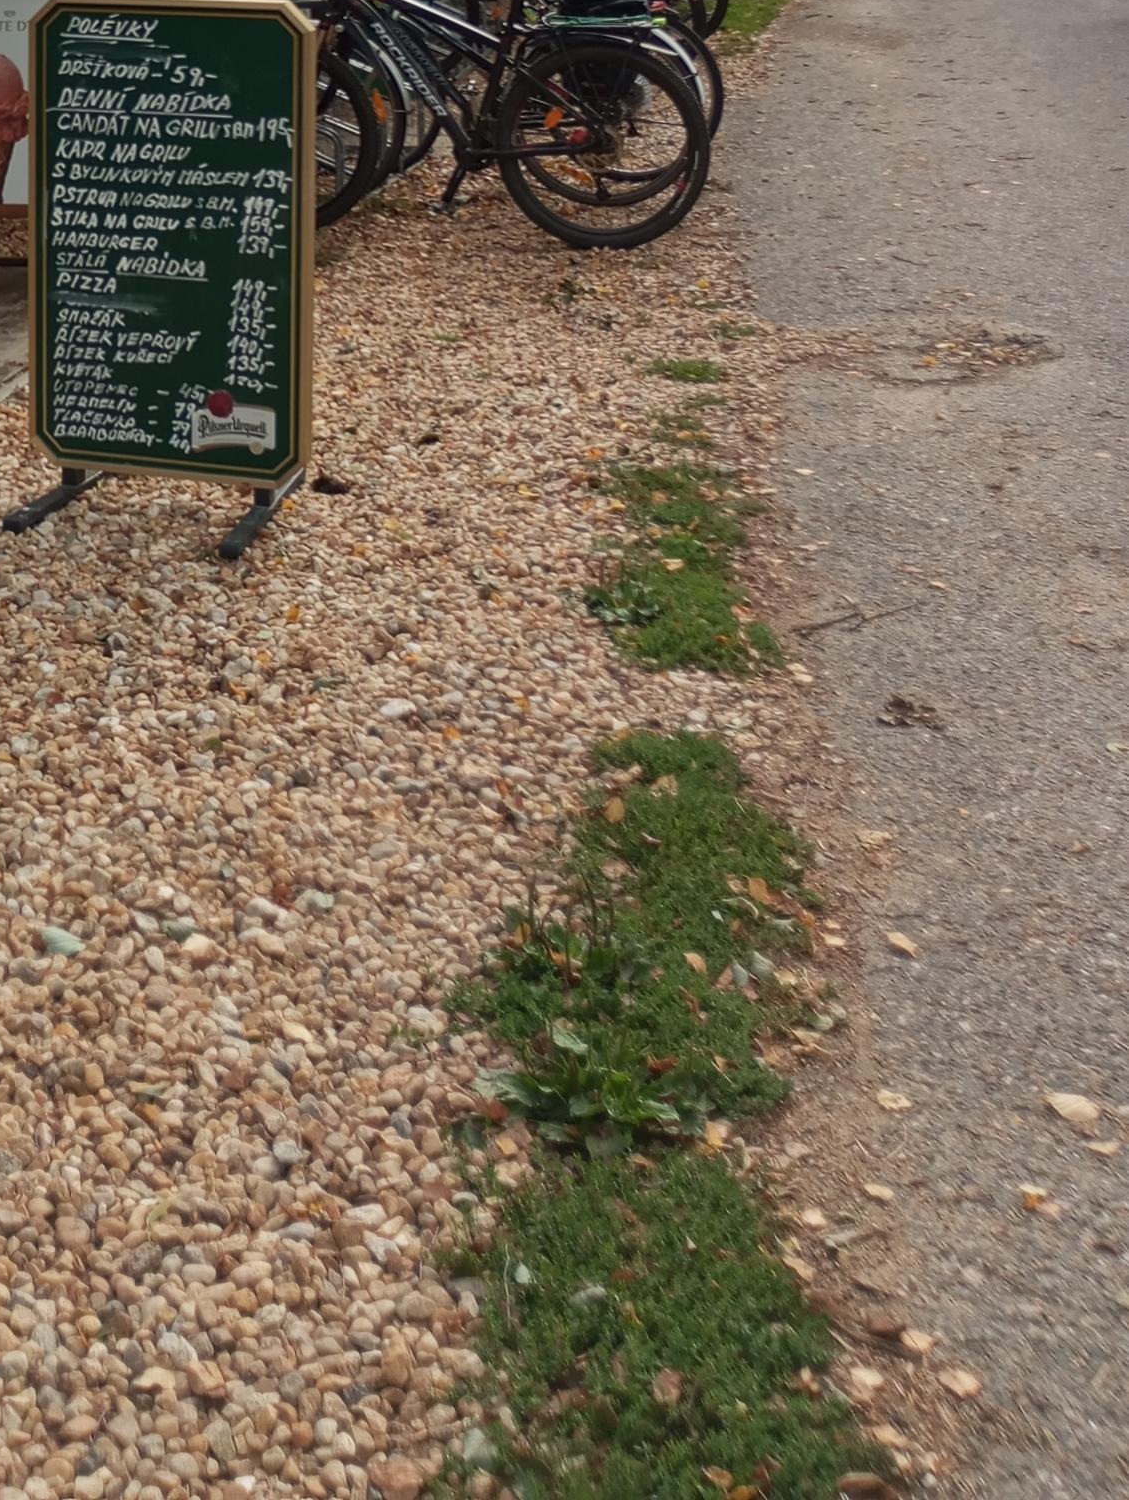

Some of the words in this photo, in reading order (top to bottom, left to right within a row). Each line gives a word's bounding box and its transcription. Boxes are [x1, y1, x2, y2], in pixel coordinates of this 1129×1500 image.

[67, 14, 159, 41] POLÉVKY
[370, 23, 448, 116] ROCKRIDER
[58, 86, 136, 110] DENNÍ
[134, 91, 232, 113] NABÍDKA
[134, 116, 162, 139] NA
[165, 118, 221, 139] GRILU
[55, 138, 107, 161] KAPR
[110, 143, 136, 163] NA
[139, 144, 192, 164] GRILU
[51, 162, 67, 178] S
[69, 163, 174, 187] BYLINKOVÝM
[177, 162, 252, 187] MÁSLEM
[143, 192, 191, 210] GRILU
[51, 207, 99, 228] ŠTIKA
[103, 213, 128, 229] NA
[132, 214, 180, 231] GRILU
[51, 231, 159, 251] HAMBURGER
[116, 252, 207, 277] NABÍDKA
[56, 273, 118, 294] PIZZA
[56, 308, 127, 328] SMAŽÁK
[54, 324, 115, 346] ŘÍZEK
[117, 329, 202, 353] VEPŘOVÝ
[53, 343, 106, 361] ŘÍZEK
[113, 348, 176, 364] KUŘECÍ
[53, 379, 139, 397] UTOPENEC
[53, 394, 138, 414] HERMELÍN
[198, 414, 232, 439] Pilsner
[232, 415, 268, 436] Urquell
